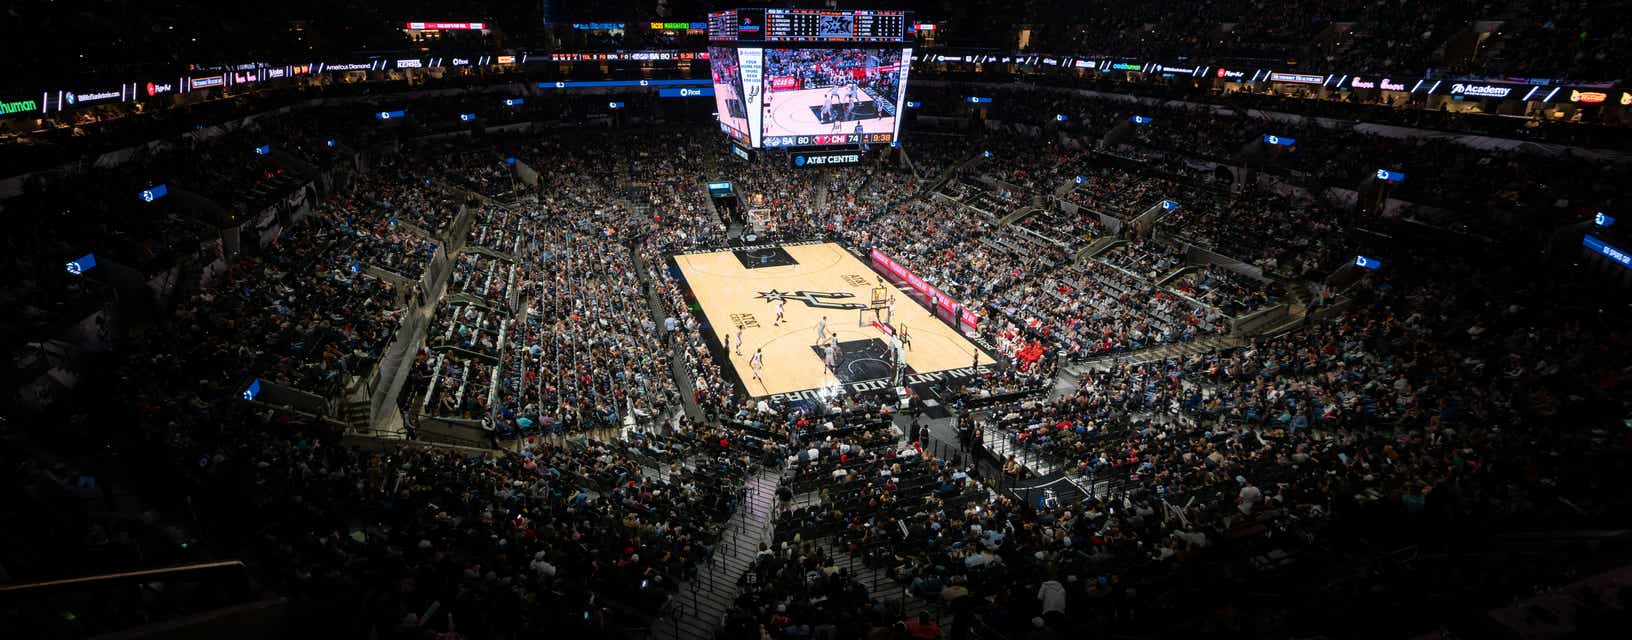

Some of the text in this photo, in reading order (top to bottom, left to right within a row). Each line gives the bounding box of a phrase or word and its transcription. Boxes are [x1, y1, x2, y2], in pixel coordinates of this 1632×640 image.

[1465, 84, 1512, 97] Academy
[832, 135, 845, 144] CHI
[848, 133, 858, 142] 74
[807, 154, 859, 165] AT&T CENTER
[852, 371, 945, 392] ANTNIO
